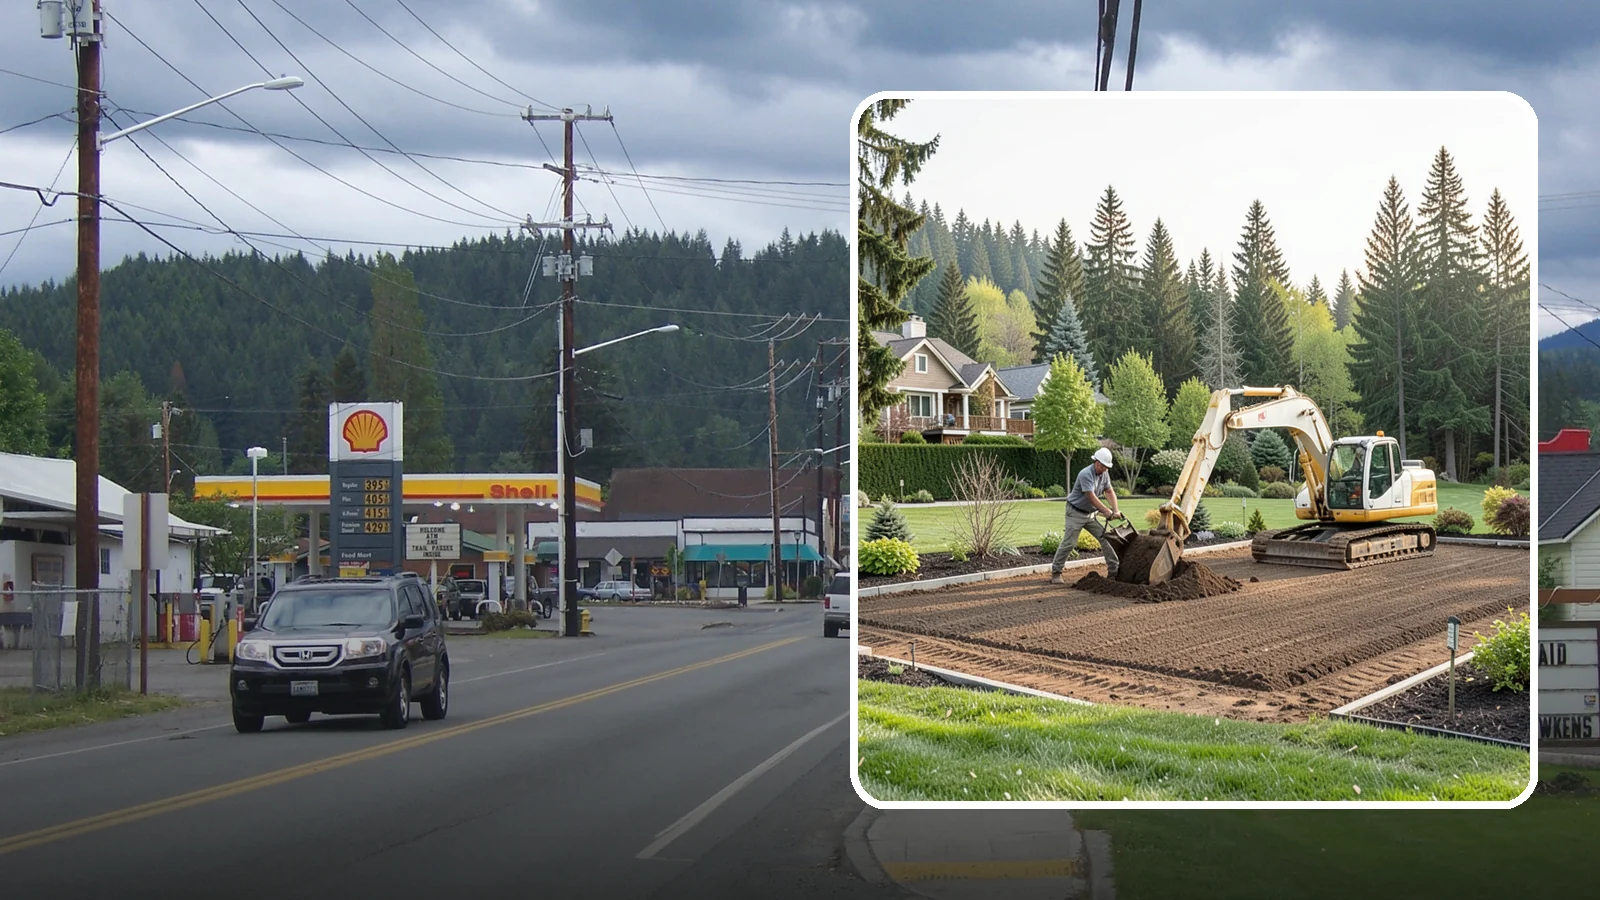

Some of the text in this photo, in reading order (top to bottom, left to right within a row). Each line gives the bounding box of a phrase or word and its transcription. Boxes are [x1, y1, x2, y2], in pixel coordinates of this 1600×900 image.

[366, 480, 383, 490] 395
[489, 484, 547, 499] Shell
[366, 494, 383, 504] 405
[366, 508, 383, 518] 415
[366, 522, 383, 532] 429
[1538, 643, 1567, 665] AID
